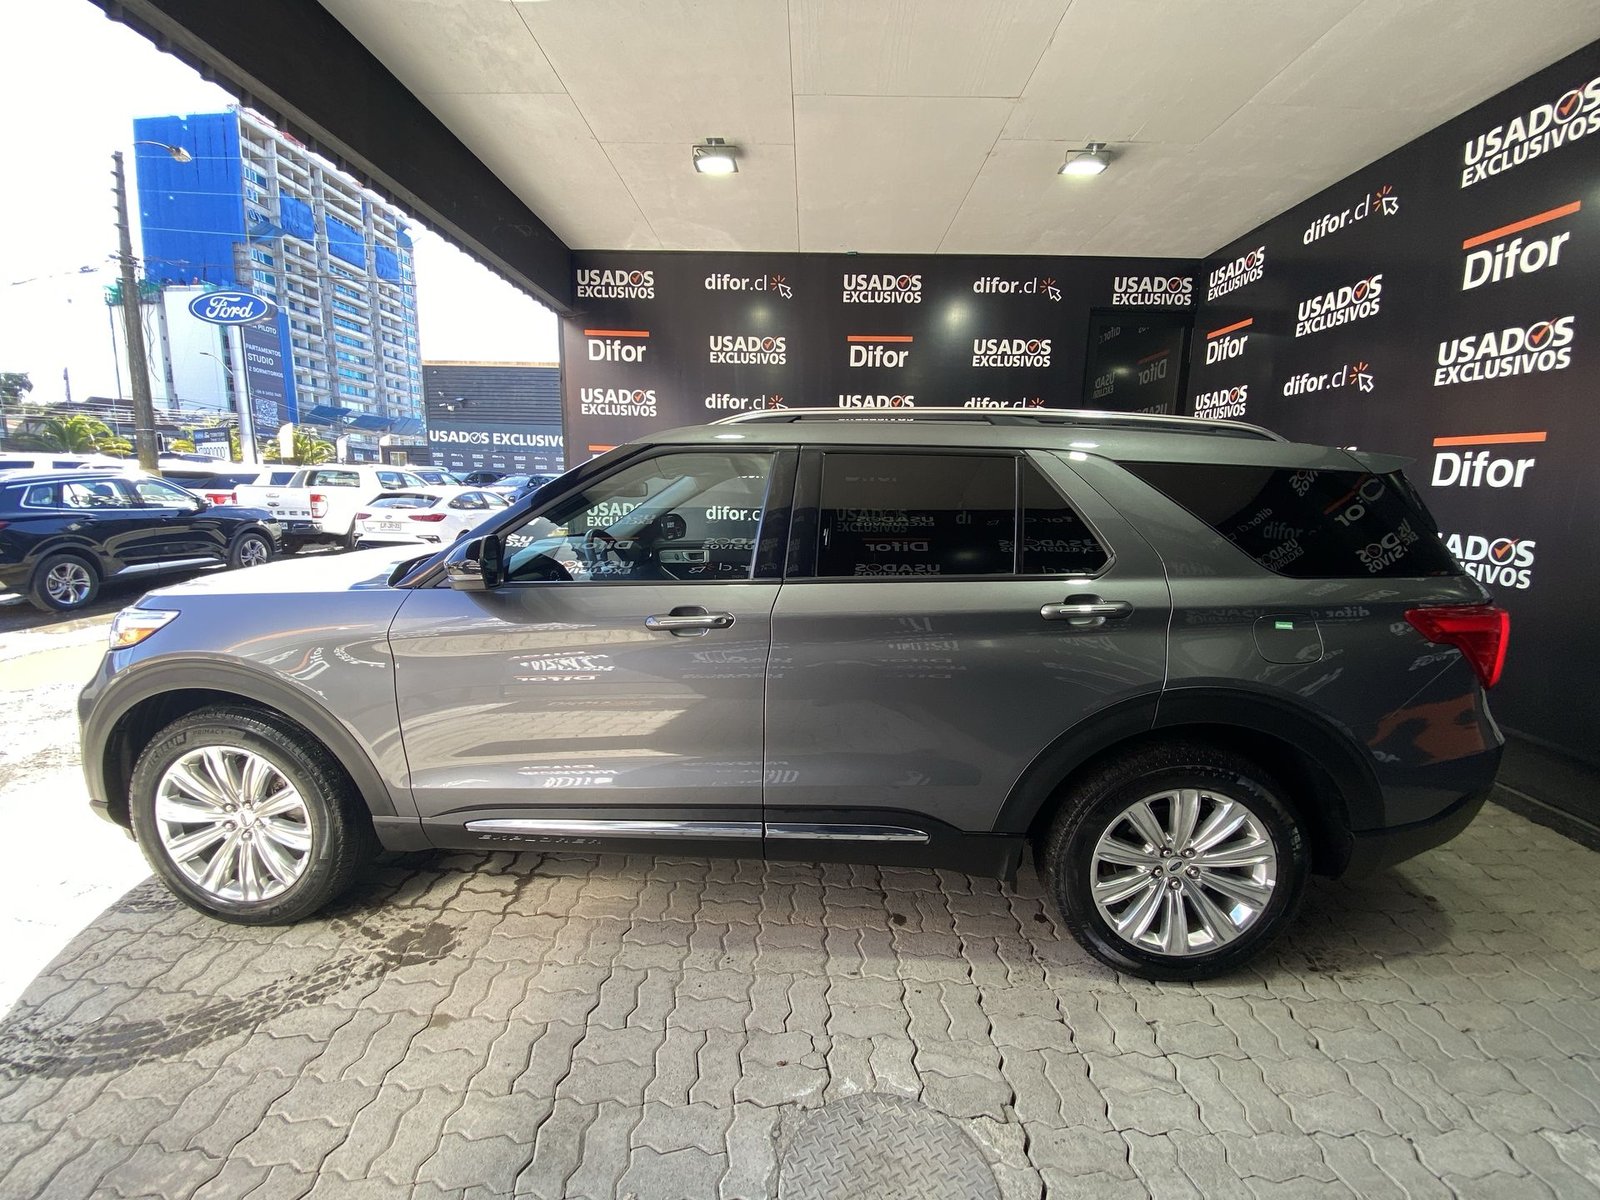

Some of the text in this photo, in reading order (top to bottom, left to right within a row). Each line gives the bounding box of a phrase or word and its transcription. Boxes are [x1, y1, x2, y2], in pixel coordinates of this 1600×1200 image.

[1303, 193, 1370, 245] difor.cl
[1209, 245, 1265, 288] USADOS
[1463, 231, 1570, 291] Difor
[577, 269, 653, 287] USADOS
[705, 274, 767, 291] difor.cl
[843, 274, 922, 291] USADOS
[973, 277, 1036, 294] difor.cl
[1113, 276, 1193, 294] USADOS
[1207, 264, 1263, 301] EXCLUSIVOS
[577, 286, 654, 299] EXCLUSIVOS
[843, 291, 922, 304] EXCLUSIVOS
[1112, 293, 1192, 306] EXCLUSIVOS
[1297, 274, 1382, 321] USADOS
[206, 296, 253, 318] Ford
[1295, 298, 1380, 338] EXCLUSIVOS
[709, 335, 786, 352] USADOS
[973, 338, 1052, 356] USADOS
[1437, 315, 1575, 366] USADOS
[588, 339, 646, 362] Difor
[709, 352, 786, 365] EXCLUSIVOS
[849, 345, 909, 367] Difor
[1206, 335, 1248, 365] Difor
[247, 353, 274, 366] STUDIO
[972, 355, 1051, 368] EXCLUSIVOS
[1433, 347, 1572, 387] EXCLUSIVOS
[1283, 365, 1348, 397] difor.cl
[580, 388, 656, 405] USADOS
[705, 393, 765, 410] difor.cl
[839, 395, 914, 408] USADOS
[1195, 385, 1248, 411] USADOS
[581, 404, 657, 417] EXCLUSIVOS
[1194, 402, 1246, 420] EXCLUSIVOS
[430, 430, 489, 445] USADOS
[1431, 450, 1535, 488] Difor
[706, 506, 760, 521] difor.c
